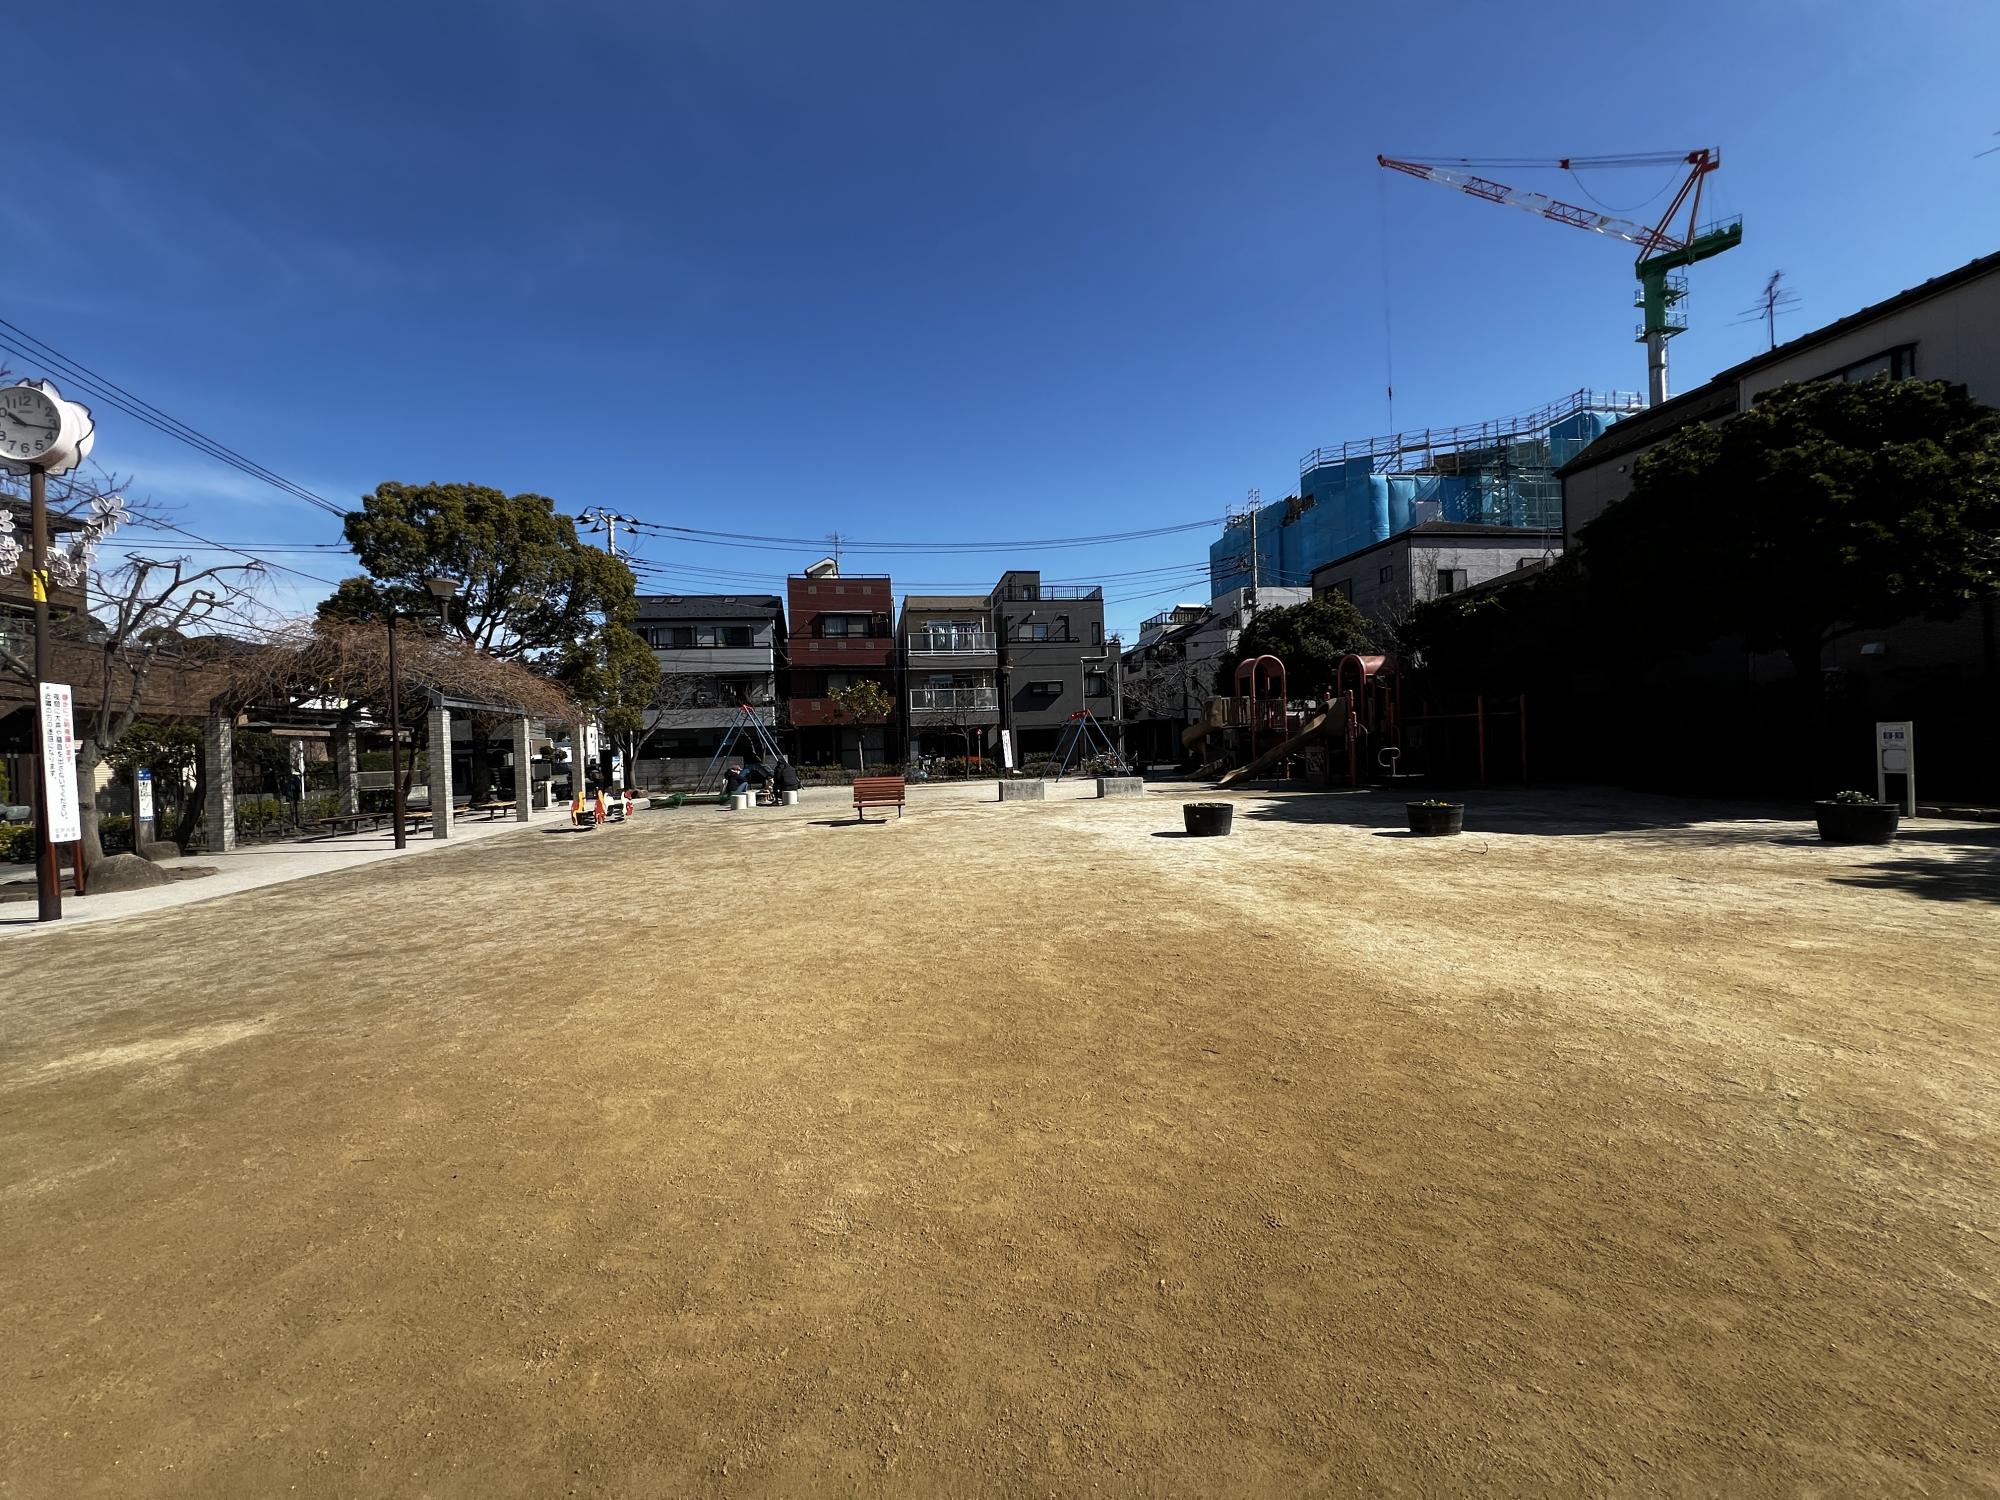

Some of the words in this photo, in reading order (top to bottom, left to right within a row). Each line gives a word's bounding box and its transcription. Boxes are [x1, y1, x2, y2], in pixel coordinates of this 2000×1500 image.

[19, 395, 32, 407] 12
[44, 406, 53, 417] 2
[48, 418, 57, 430] 3
[44, 431, 53, 440] 4
[8, 440, 17, 450] 7
[20, 442, 30, 454] 6
[35, 440, 44, 450] 5
